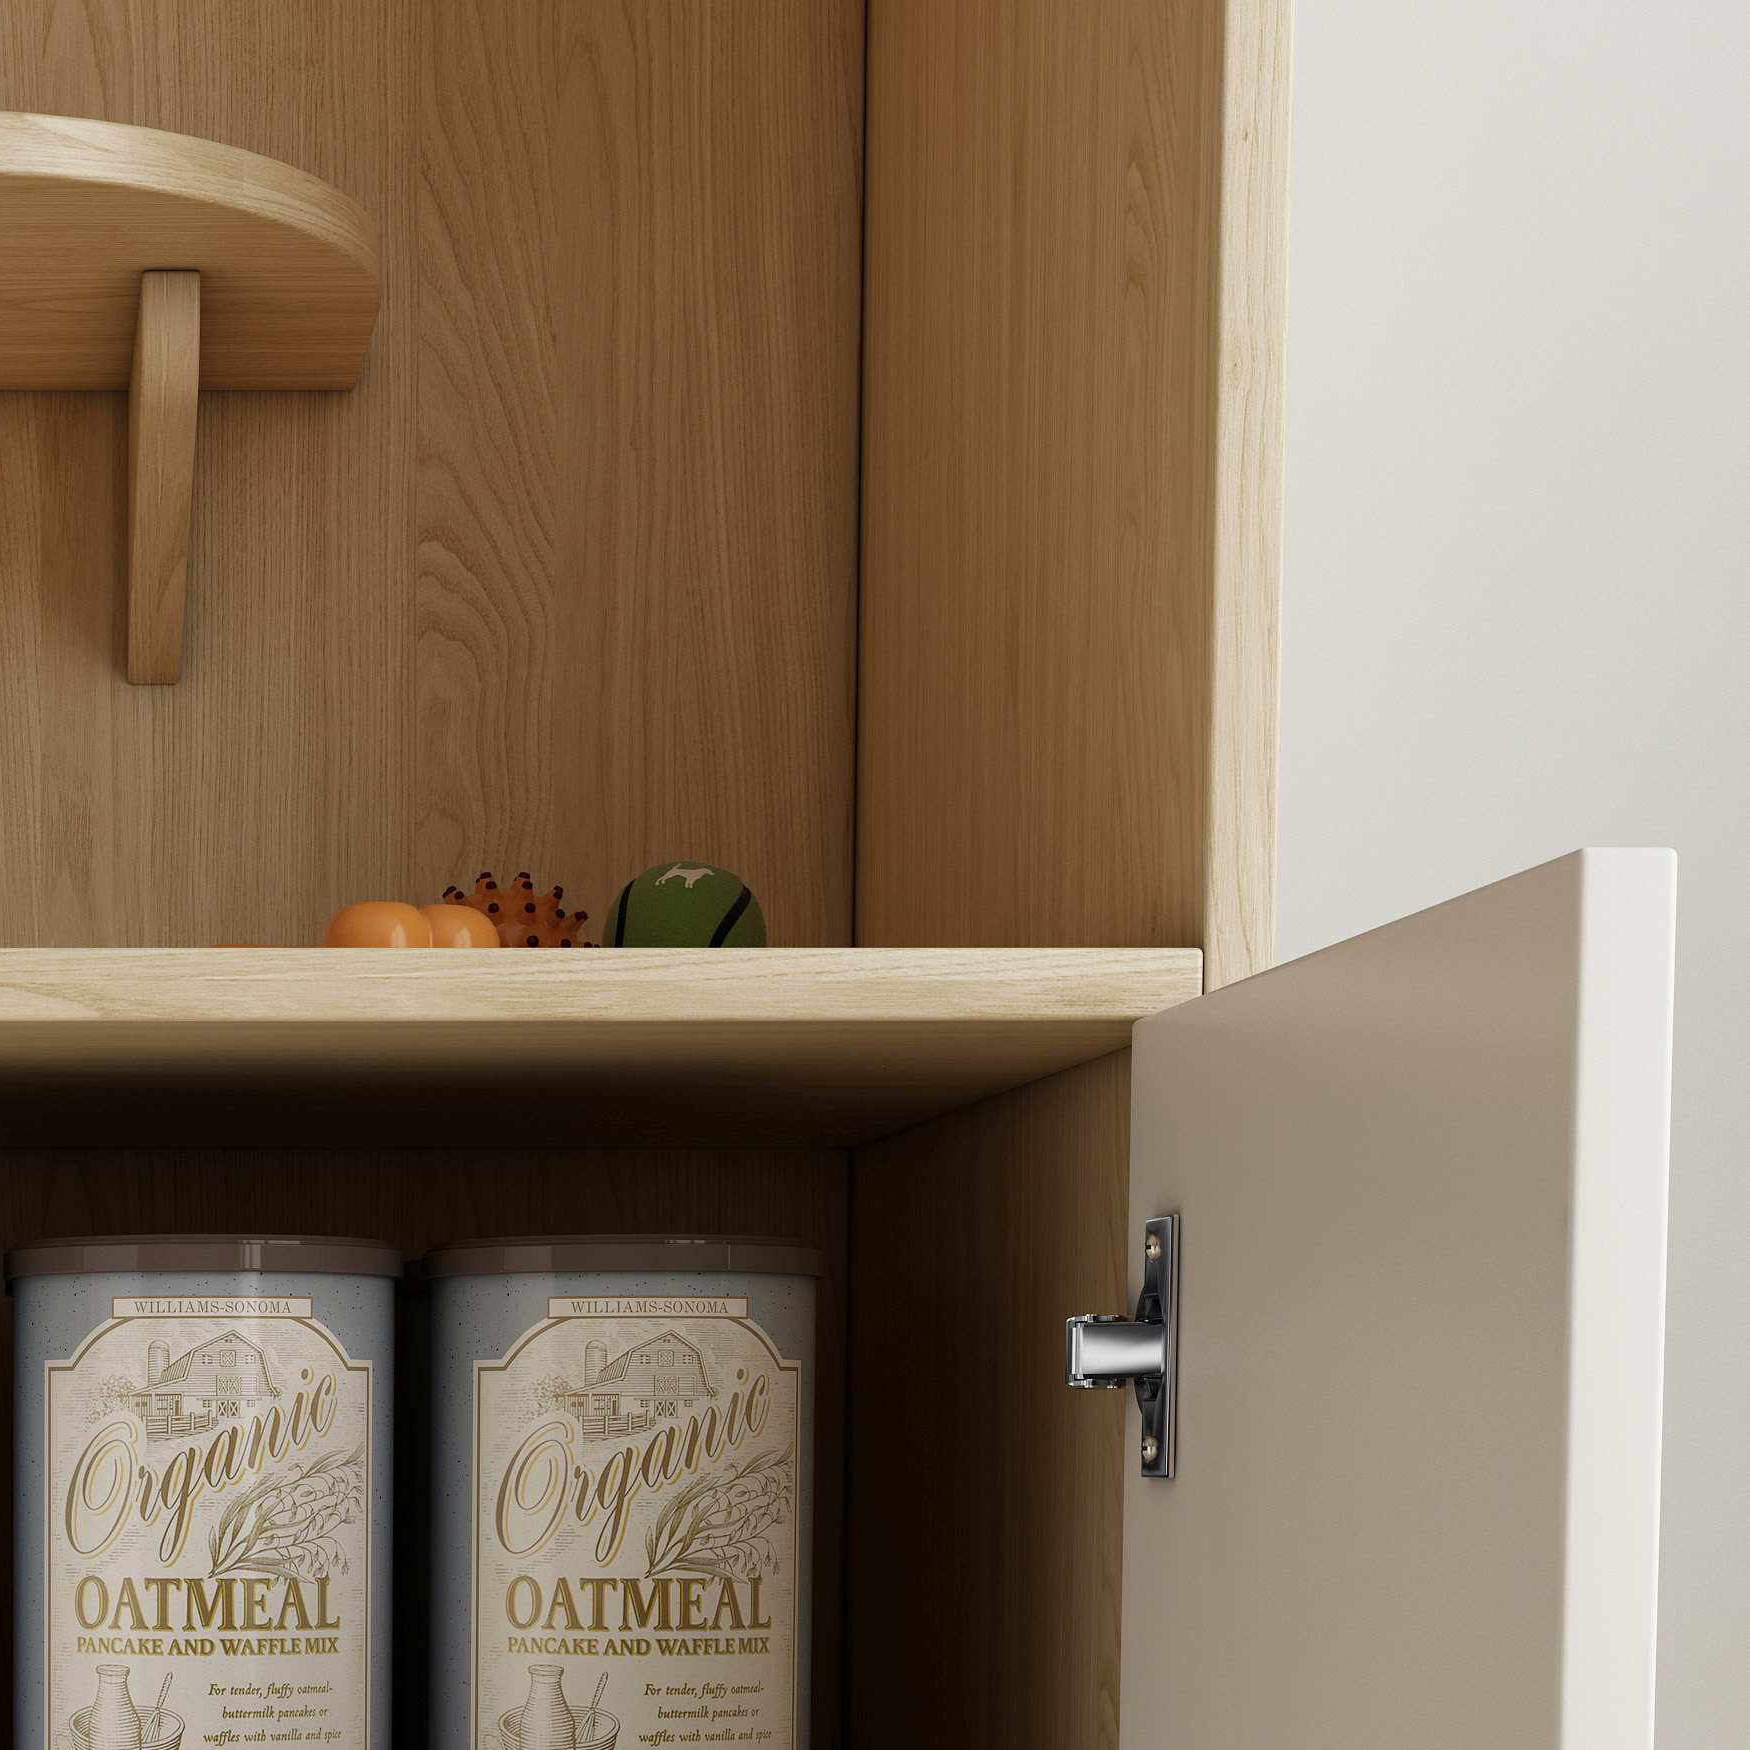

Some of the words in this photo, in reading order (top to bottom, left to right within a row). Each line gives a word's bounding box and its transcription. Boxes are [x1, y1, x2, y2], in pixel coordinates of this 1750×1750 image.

[134, 1301, 292, 1314] WILLIAMS-SONOMA
[571, 1301, 728, 1314] WILLIAMS-SONOMA
[64, 1367, 338, 1566] Organic
[496, 1367, 770, 1566] Organic
[74, 1574, 341, 1632] OATMEAL
[505, 1574, 772, 1632] OATMEAL
[76, 1636, 162, 1656] PANCAKE
[168, 1638, 216, 1656] AND
[219, 1637, 301, 1656] WAFFLE
[305, 1636, 339, 1655] MIX
[507, 1636, 598, 1656] PANCAKE
[604, 1638, 652, 1656] AND
[655, 1637, 735, 1656] WAFFLE
[738, 1636, 770, 1655] MIX
[208, 1683, 226, 1696] For
[230, 1683, 264, 1698] tender,
[264, 1682, 294, 1698] fluffy
[221, 1705, 275, 1718] buttermilk
[277, 1707, 316, 1722] pancakes
[319, 1708, 329, 1717] or
